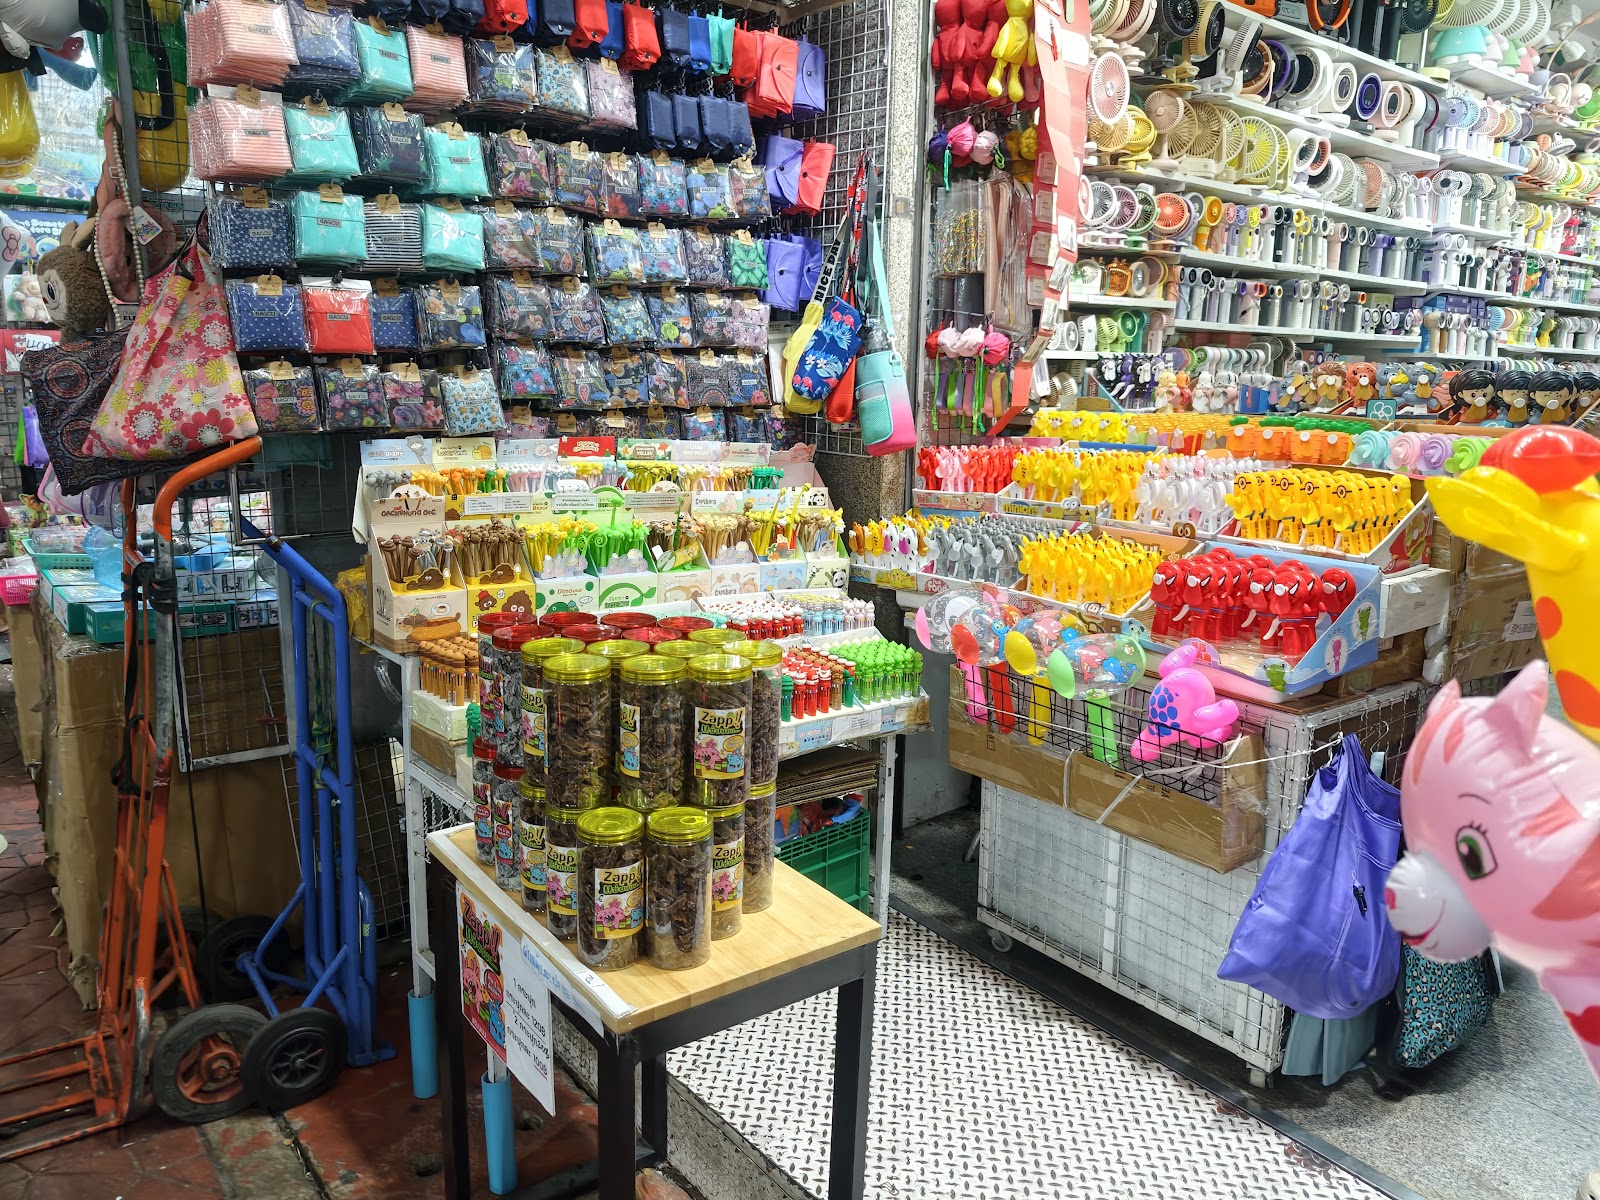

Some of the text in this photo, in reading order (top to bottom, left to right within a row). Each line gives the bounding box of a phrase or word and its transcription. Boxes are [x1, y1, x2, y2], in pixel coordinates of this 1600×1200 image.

[814, 239, 842, 301] NICE DAY
[702, 710, 743, 729] Zapp!!
